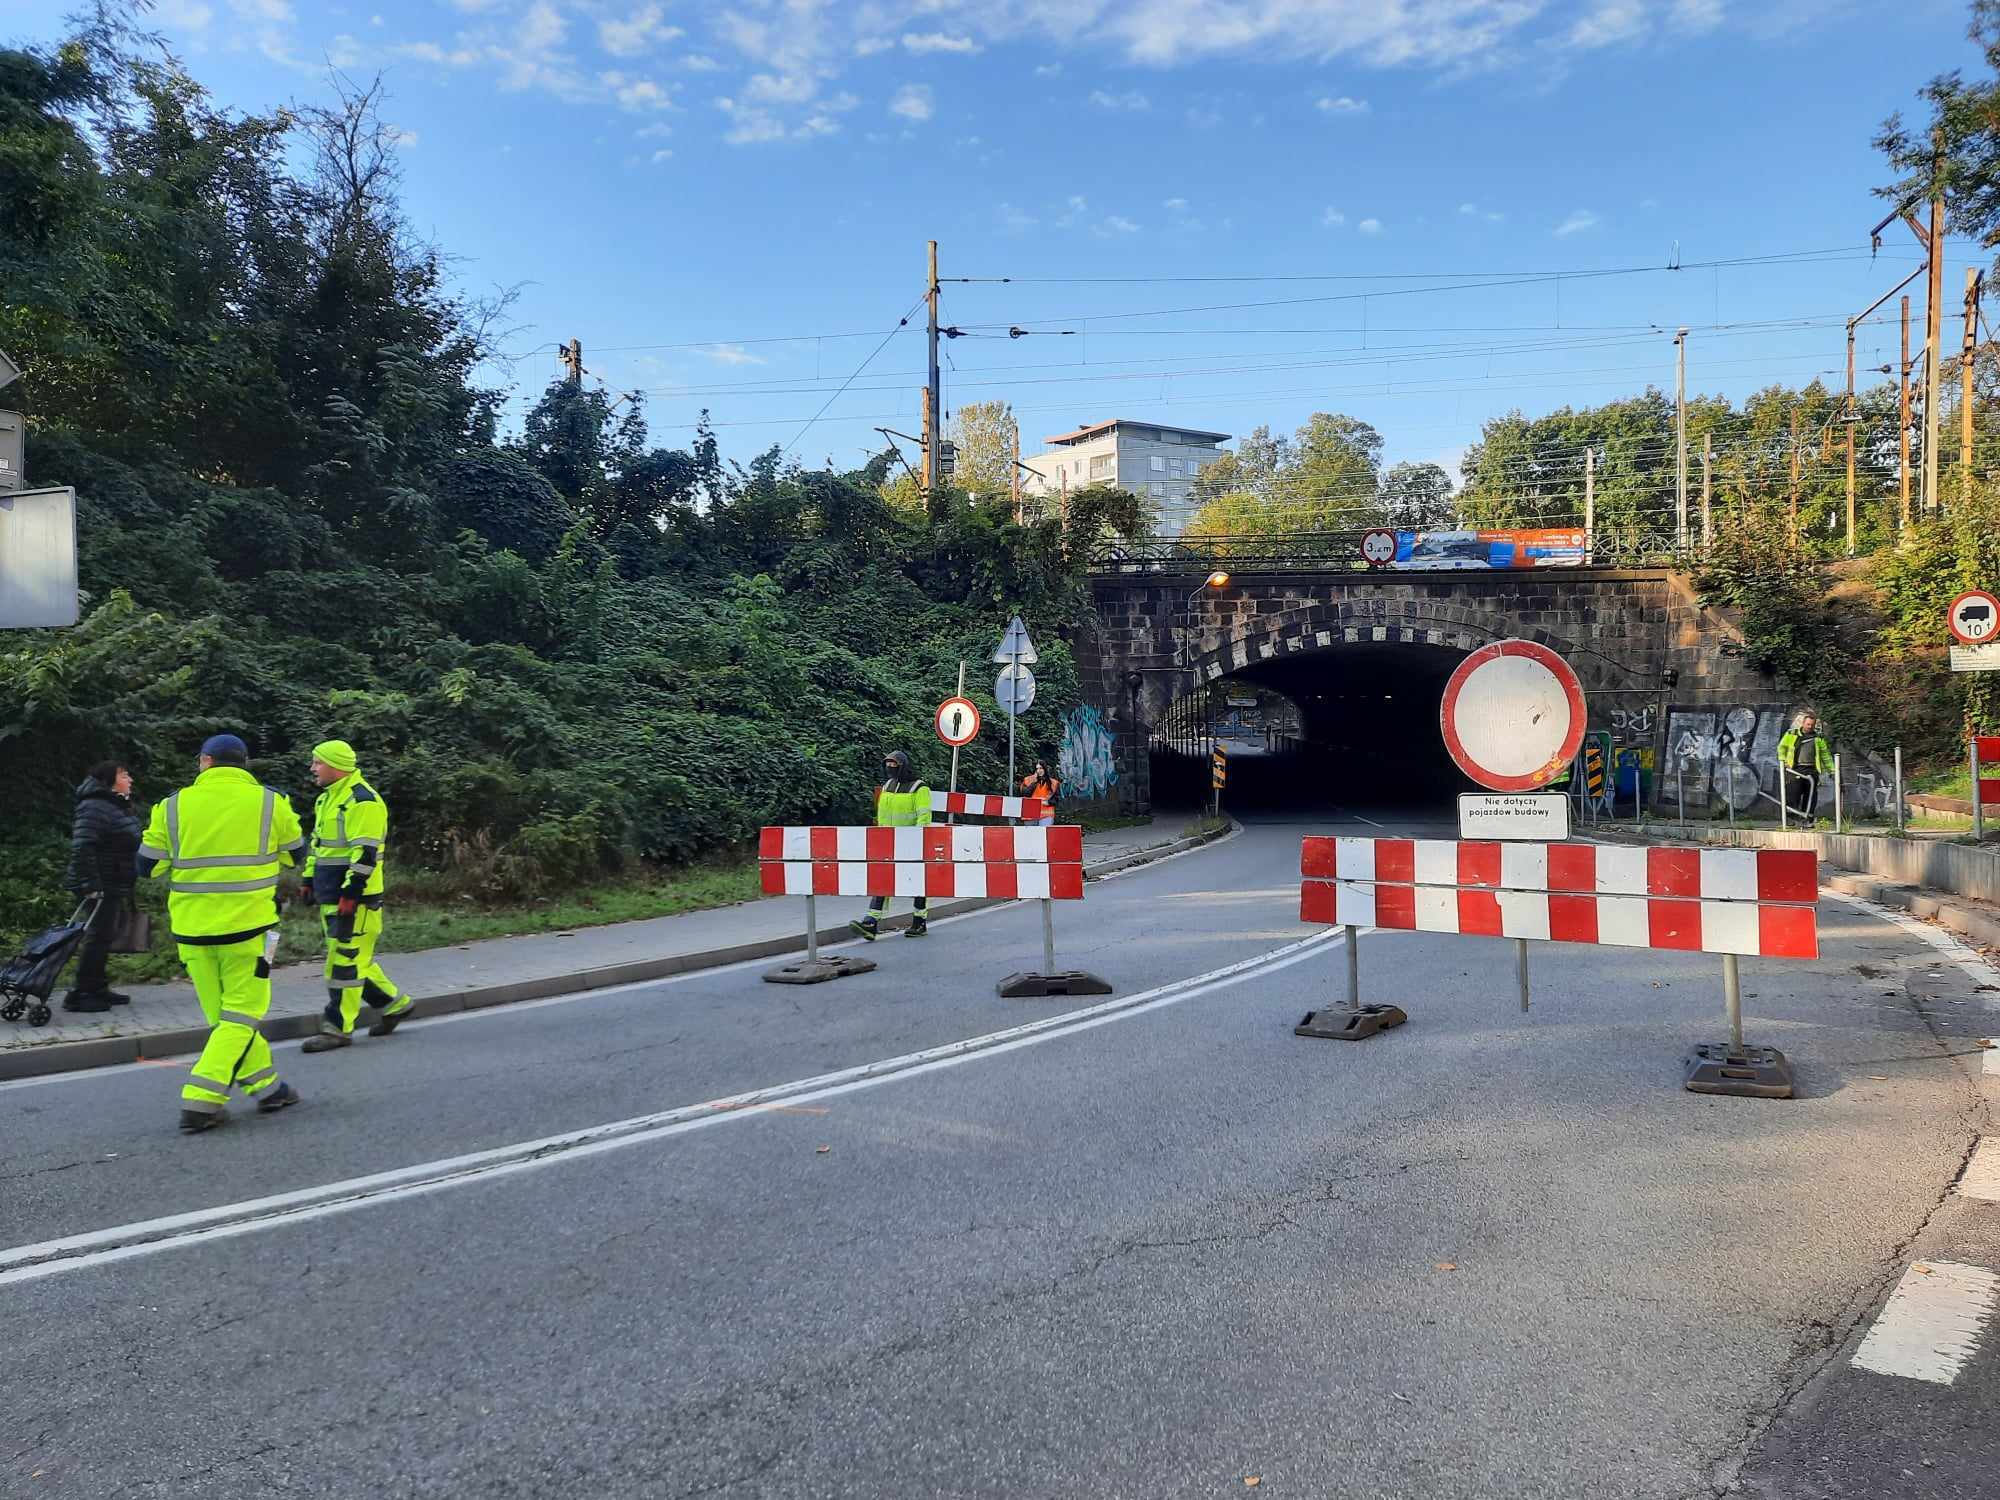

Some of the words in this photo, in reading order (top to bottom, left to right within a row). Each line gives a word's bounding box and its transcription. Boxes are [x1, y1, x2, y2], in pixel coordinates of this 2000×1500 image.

[1968, 624, 1982, 636] 10
[1504, 797, 1537, 806] dotyczy
[1514, 808, 1549, 817] budowy
